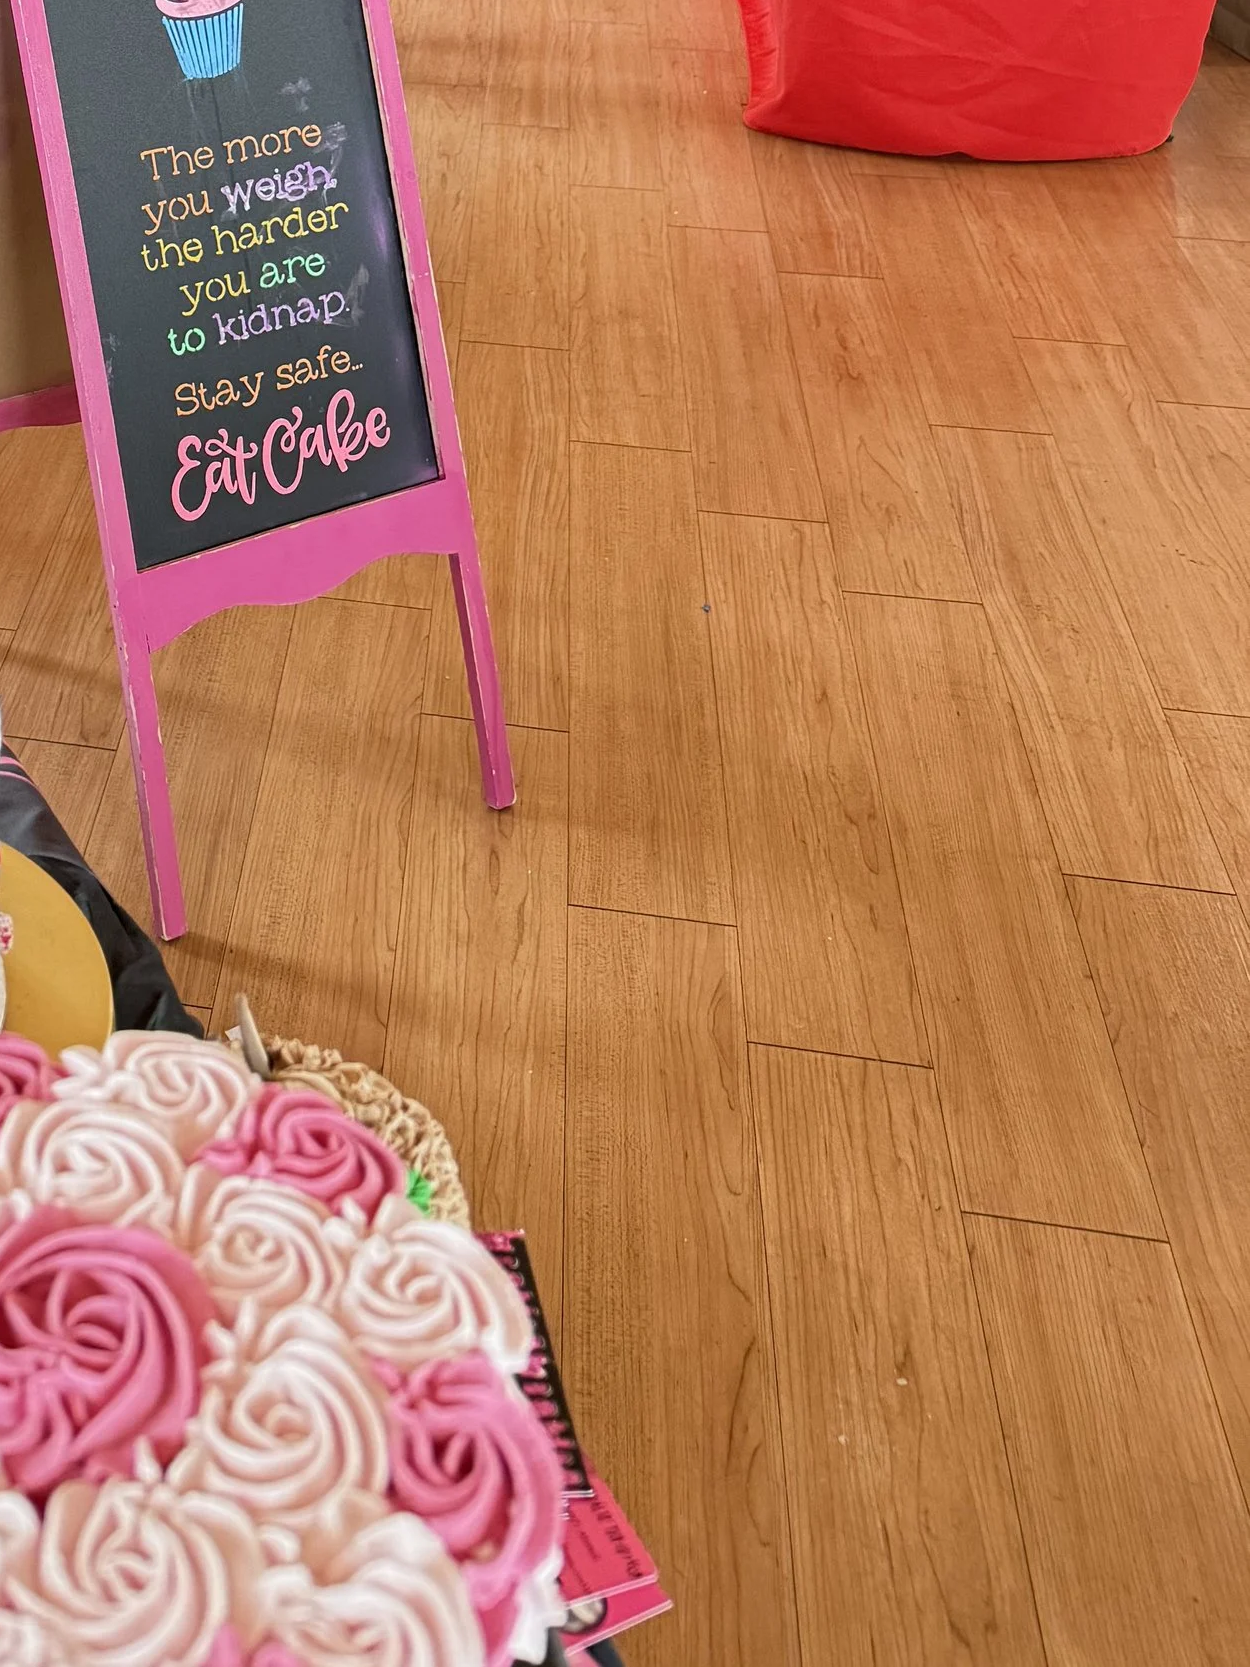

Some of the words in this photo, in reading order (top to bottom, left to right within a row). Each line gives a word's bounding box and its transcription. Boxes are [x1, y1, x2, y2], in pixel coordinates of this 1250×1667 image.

[140, 145, 215, 181] The
[223, 124, 322, 164] more
[141, 190, 214, 235] you
[141, 238, 204, 272] the
[211, 202, 349, 255] harder
[179, 271, 251, 317] you
[259, 253, 326, 289] are
[167, 327, 206, 356] to
[212, 290, 351, 345] kidnap.
[174, 371, 265, 417] Stay
[171, 428, 258, 522] Eat
[262, 388, 391, 495] Cake
